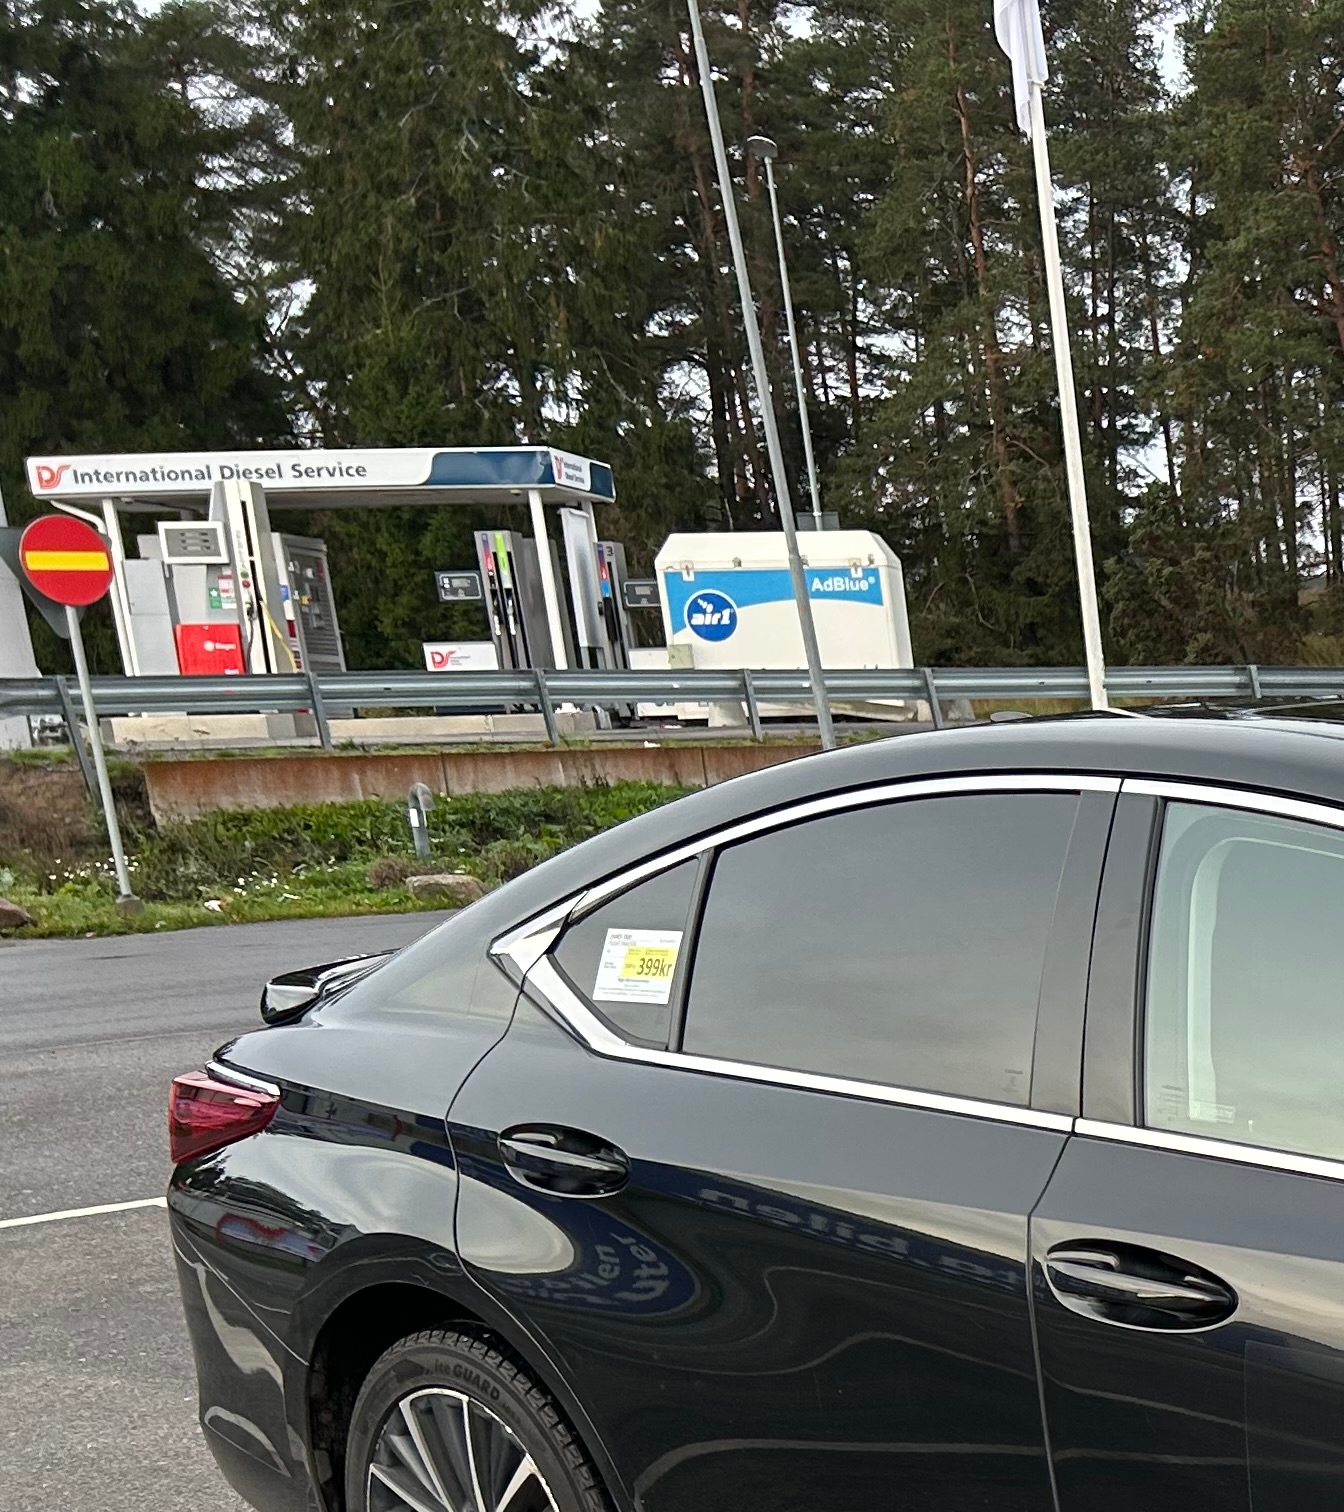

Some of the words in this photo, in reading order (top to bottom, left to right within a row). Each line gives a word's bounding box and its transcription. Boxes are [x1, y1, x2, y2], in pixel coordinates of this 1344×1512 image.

[73, 463, 213, 485] International
[219, 463, 284, 481] Diesel
[291, 461, 368, 480] Service
